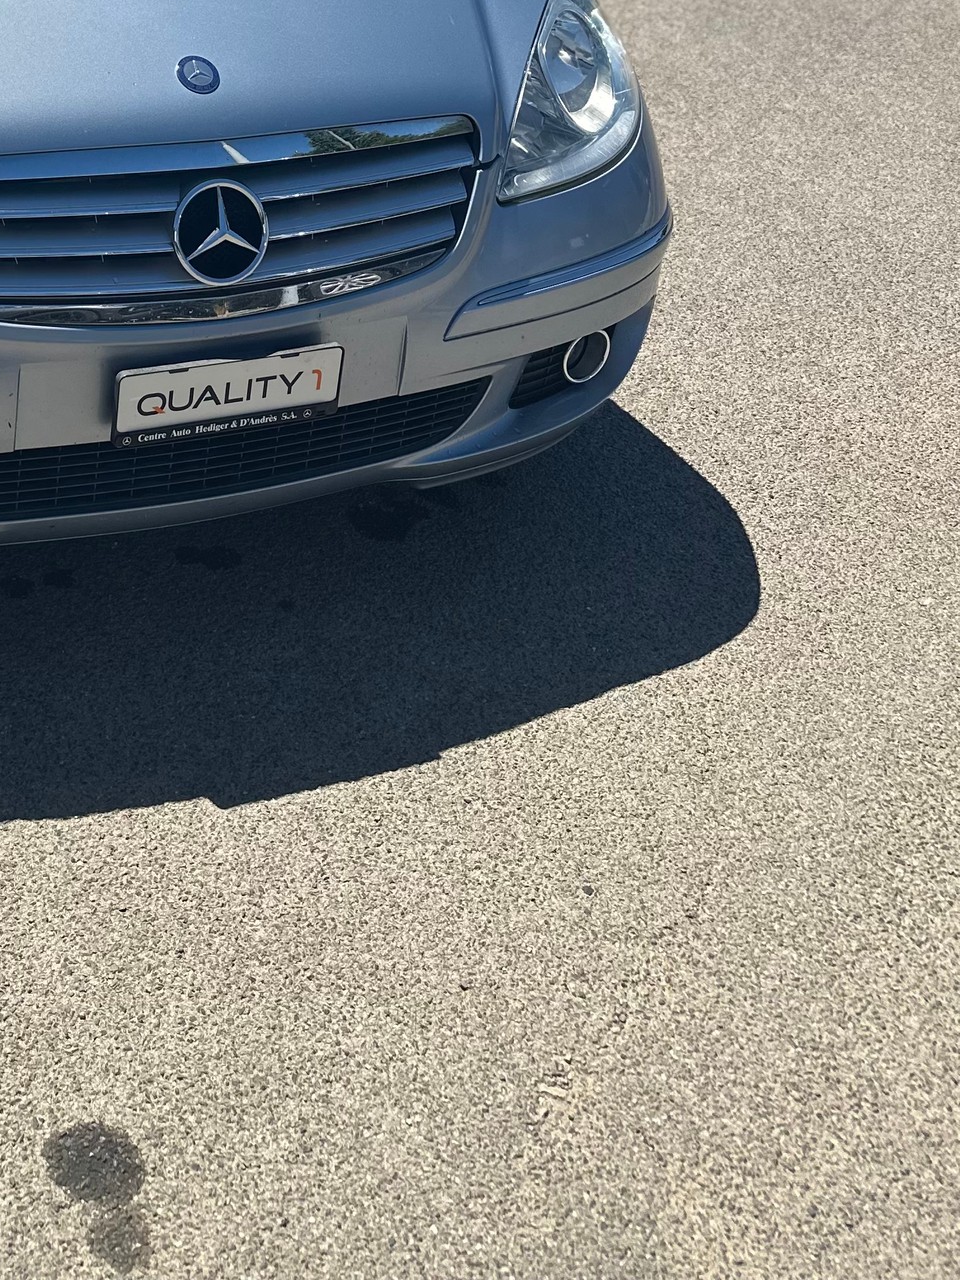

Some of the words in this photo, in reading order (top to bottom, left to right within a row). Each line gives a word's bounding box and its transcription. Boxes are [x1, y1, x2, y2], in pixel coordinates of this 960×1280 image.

[137, 371, 303, 416] QUALITY
[312, 369, 322, 390] 1
[138, 431, 167, 443] Centre
[170, 427, 191, 438] Auto
[195, 420, 229, 434] Hediger
[230, 420, 238, 428] &
